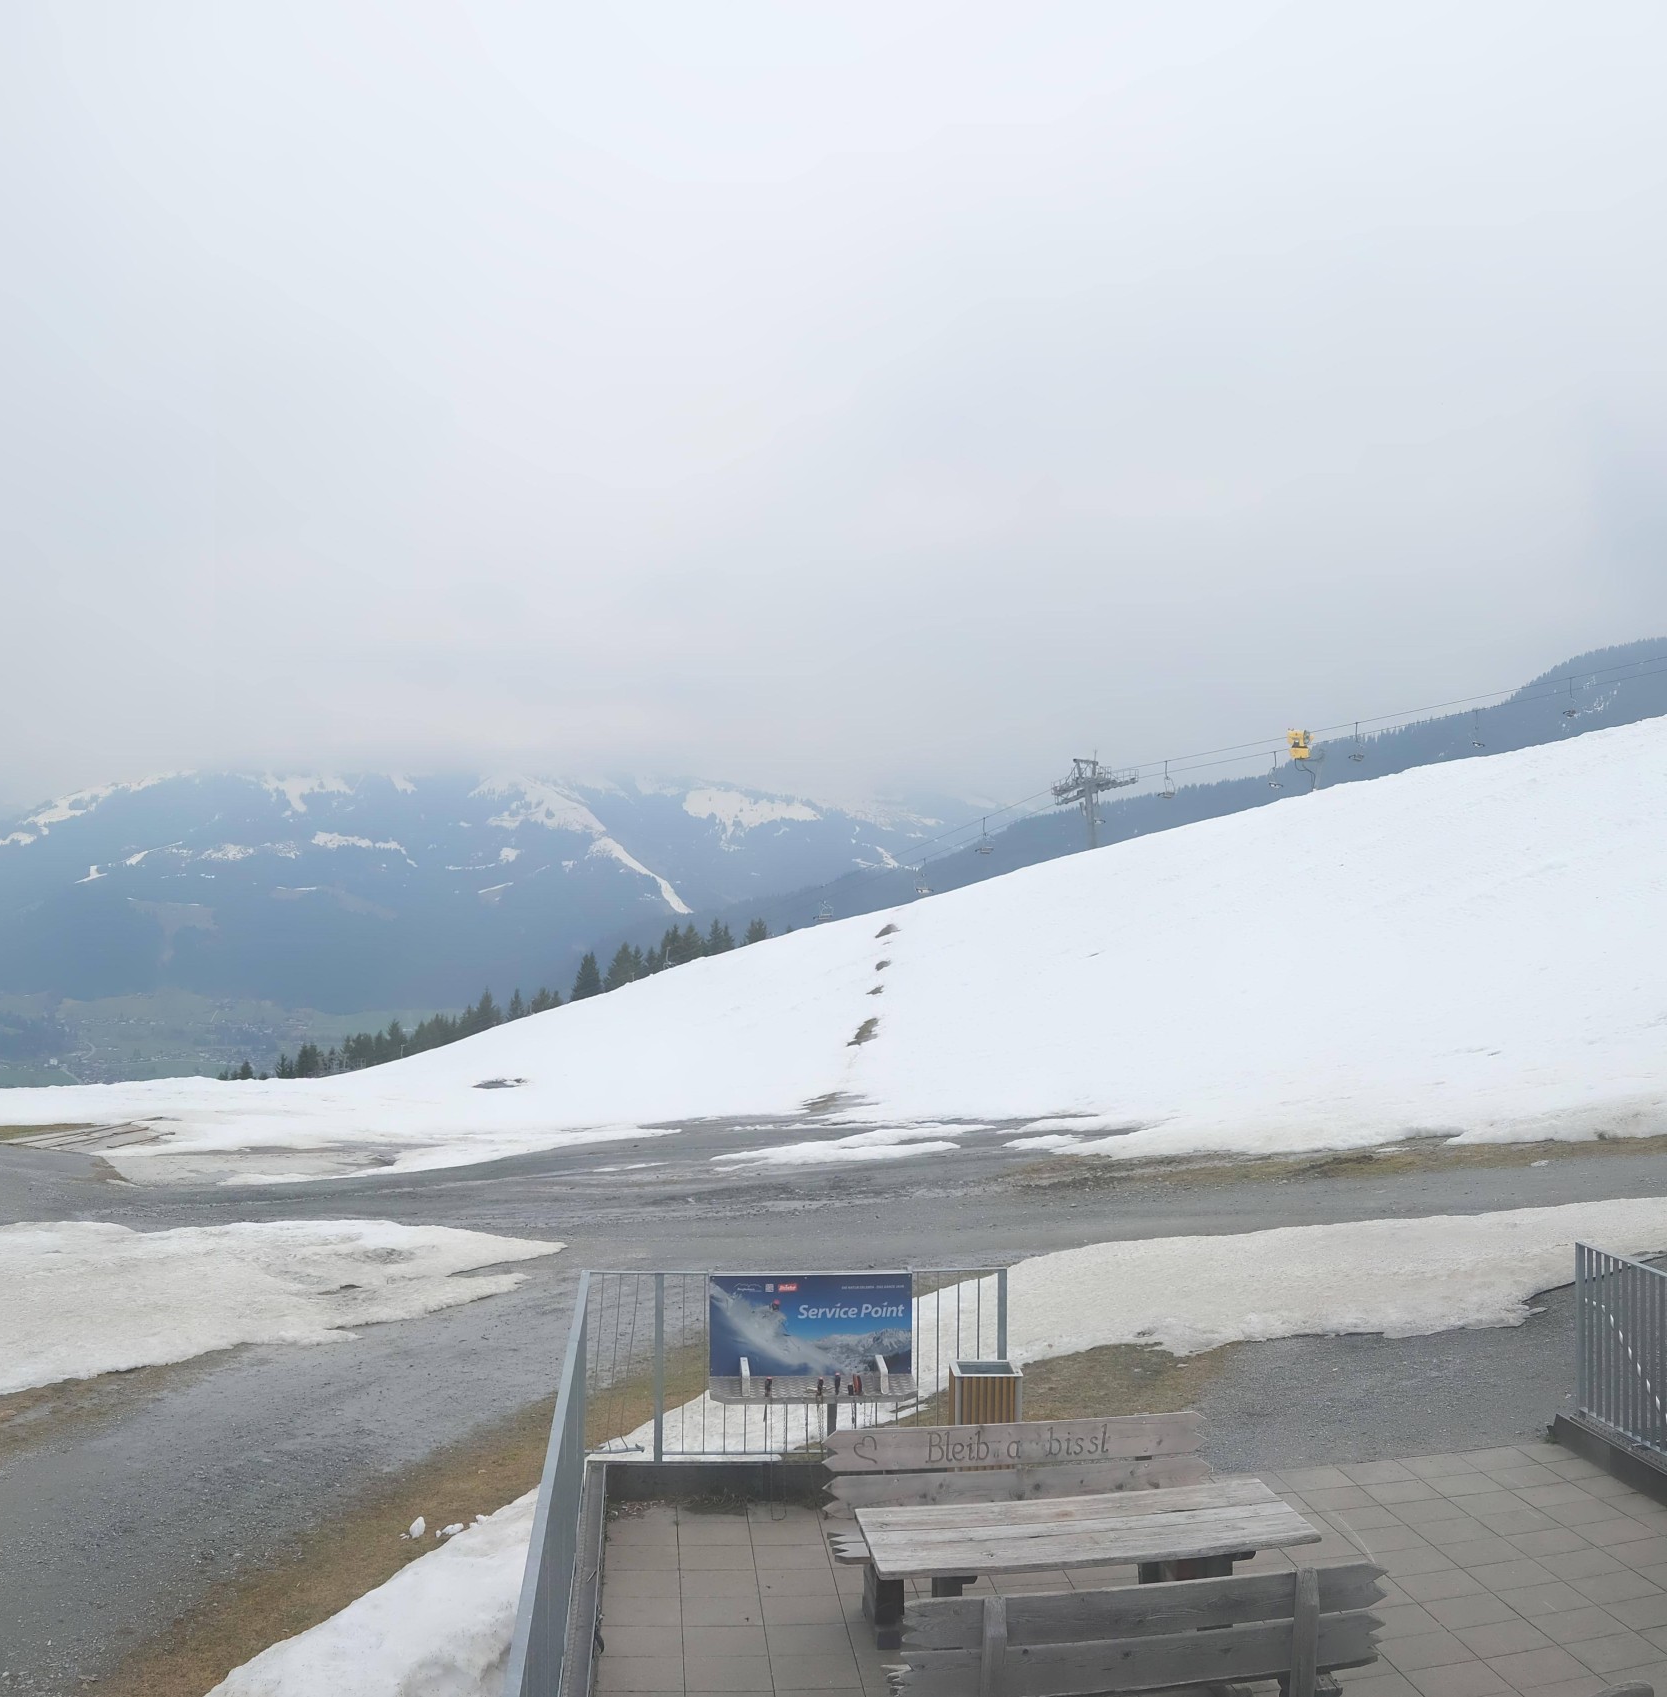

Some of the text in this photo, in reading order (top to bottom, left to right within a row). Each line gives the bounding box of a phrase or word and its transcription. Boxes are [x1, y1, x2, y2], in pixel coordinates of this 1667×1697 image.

[798, 1301, 905, 1319] Service Point
[925, 1423, 1109, 1464] Bleib a bissl
